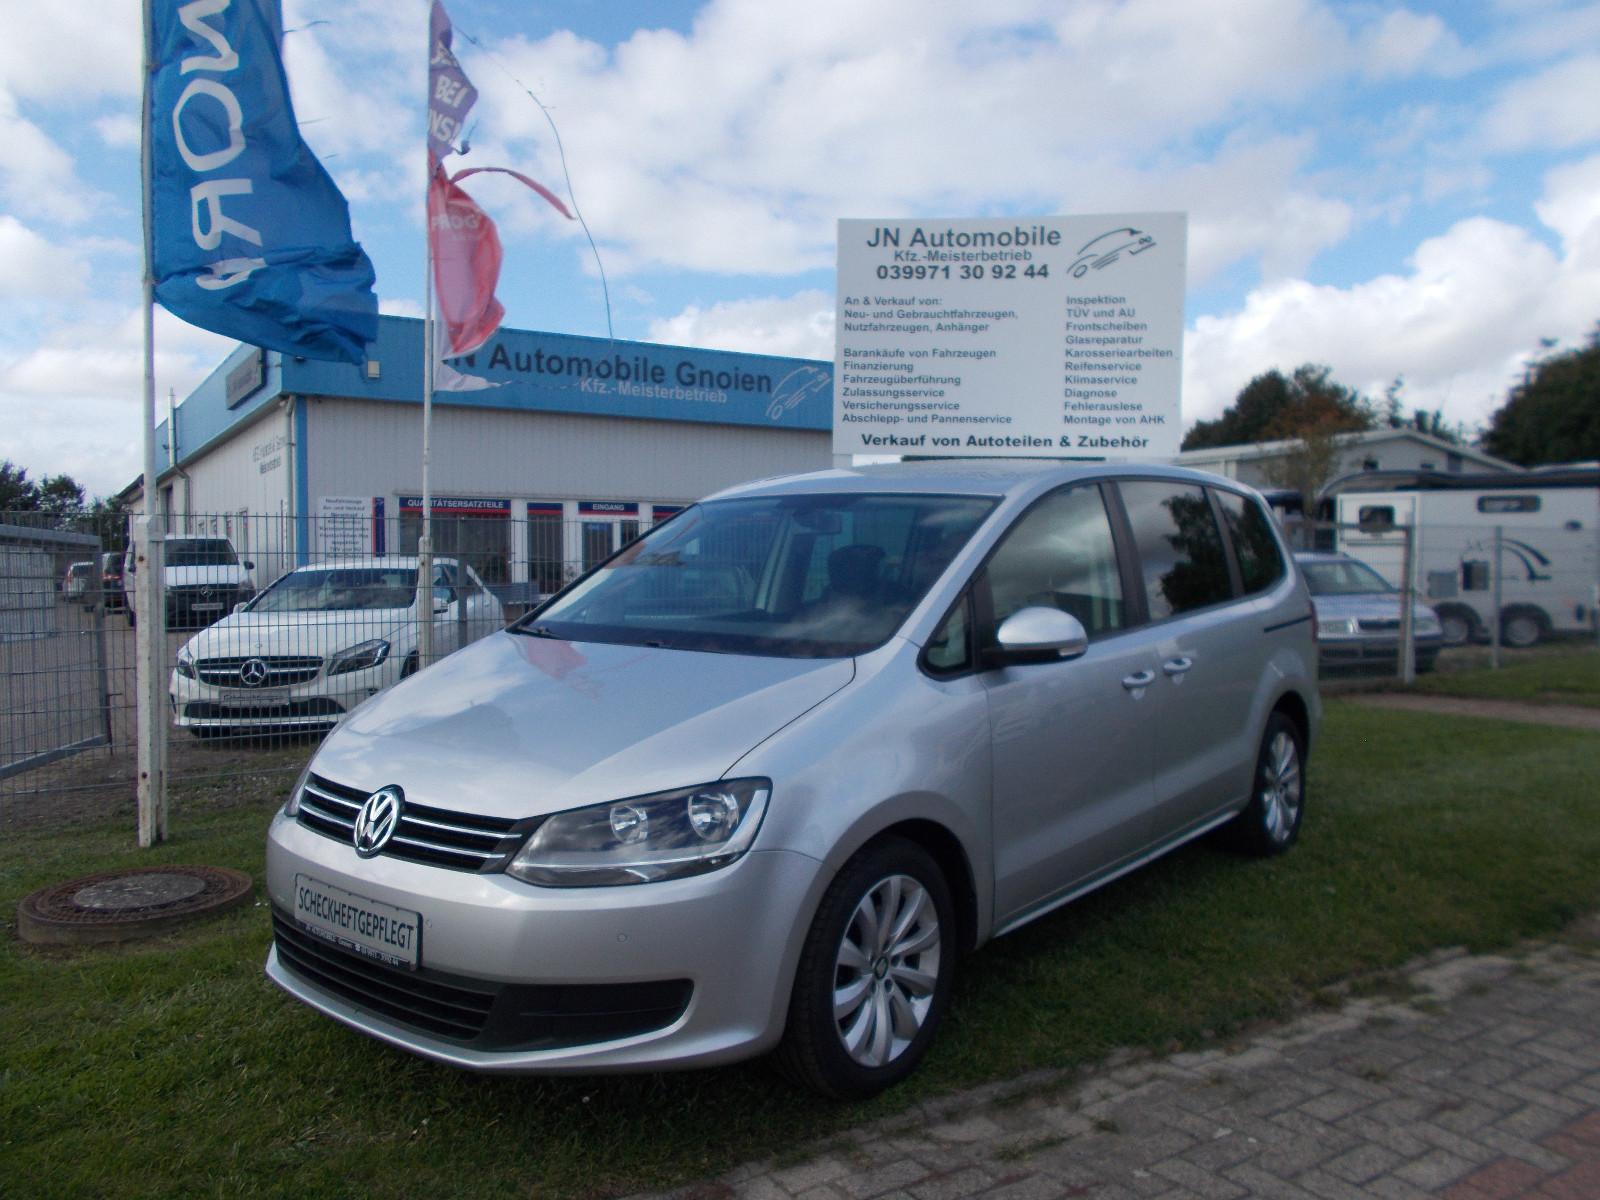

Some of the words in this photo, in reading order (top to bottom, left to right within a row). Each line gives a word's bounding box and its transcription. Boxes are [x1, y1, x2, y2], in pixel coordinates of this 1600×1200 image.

[435, 75, 469, 108] BEI
[429, 109, 462, 145] NS!
[867, 228, 900, 247] JN
[910, 226, 1061, 247] Automobile
[895, 250, 1031, 261] Kfz.-Meisterbetrieb
[877, 265, 950, 280] 039971
[960, 264, 984, 279] 30
[992, 264, 1016, 279] 92
[1025, 264, 1048, 278] 44
[845, 296, 859, 305] An
[863, 296, 870, 305] &
[874, 296, 915, 305] Verkauf
[1067, 295, 1125, 306] Inspektion
[845, 310, 869, 318] Neu-
[873, 310, 893, 318] und
[1067, 306, 1091, 318] TÜV
[1094, 308, 1115, 318] und
[1119, 308, 1135, 317] AU
[845, 323, 933, 333] Nutzfahrzeugen,
[936, 322, 989, 333] Anhänger
[1066, 321, 1147, 330] Frontscheiben
[1066, 336, 1143, 346] Glasreparatur
[844, 348, 904, 357] Barankäufe
[932, 348, 996, 359] Fahrzeugen
[1065, 348, 1172, 357] Karosseriearbeiten
[487, 343, 667, 384] Automobile
[675, 363, 772, 394] Gnoien
[844, 361, 914, 372] Finanzierung
[1065, 362, 1141, 371] Reifenservice
[843, 375, 960, 386] Fahrzeugüberführung
[1065, 375, 1137, 384] Klimaservice
[580, 381, 727, 404] Kfz.-Meisterbetrieb
[843, 388, 944, 399] Zulassungsservice
[1065, 389, 1117, 399] Diagnose
[843, 401, 959, 412] Versicherungsservice
[1065, 402, 1142, 411] Fehlerauslese
[842, 414, 904, 425] Abschlepp-
[907, 414, 927, 423] und
[932, 414, 1011, 423] Pannenservice
[1064, 415, 1112, 426] Montage
[1115, 417, 1137, 425] von
[1140, 415, 1165, 424] AHK
[861, 434, 926, 447] Verkauf
[932, 437, 960, 447] von
[967, 435, 1052, 447] Autoteilen
[1060, 436, 1071, 447] &
[1078, 435, 1149, 448] Zubehör
[407, 499, 504, 509] QUAITÄTSERSATZTEILE
[592, 503, 625, 511] EINGANG
[298, 886, 414, 950] SCHECKHEFTGEPFLEGT
